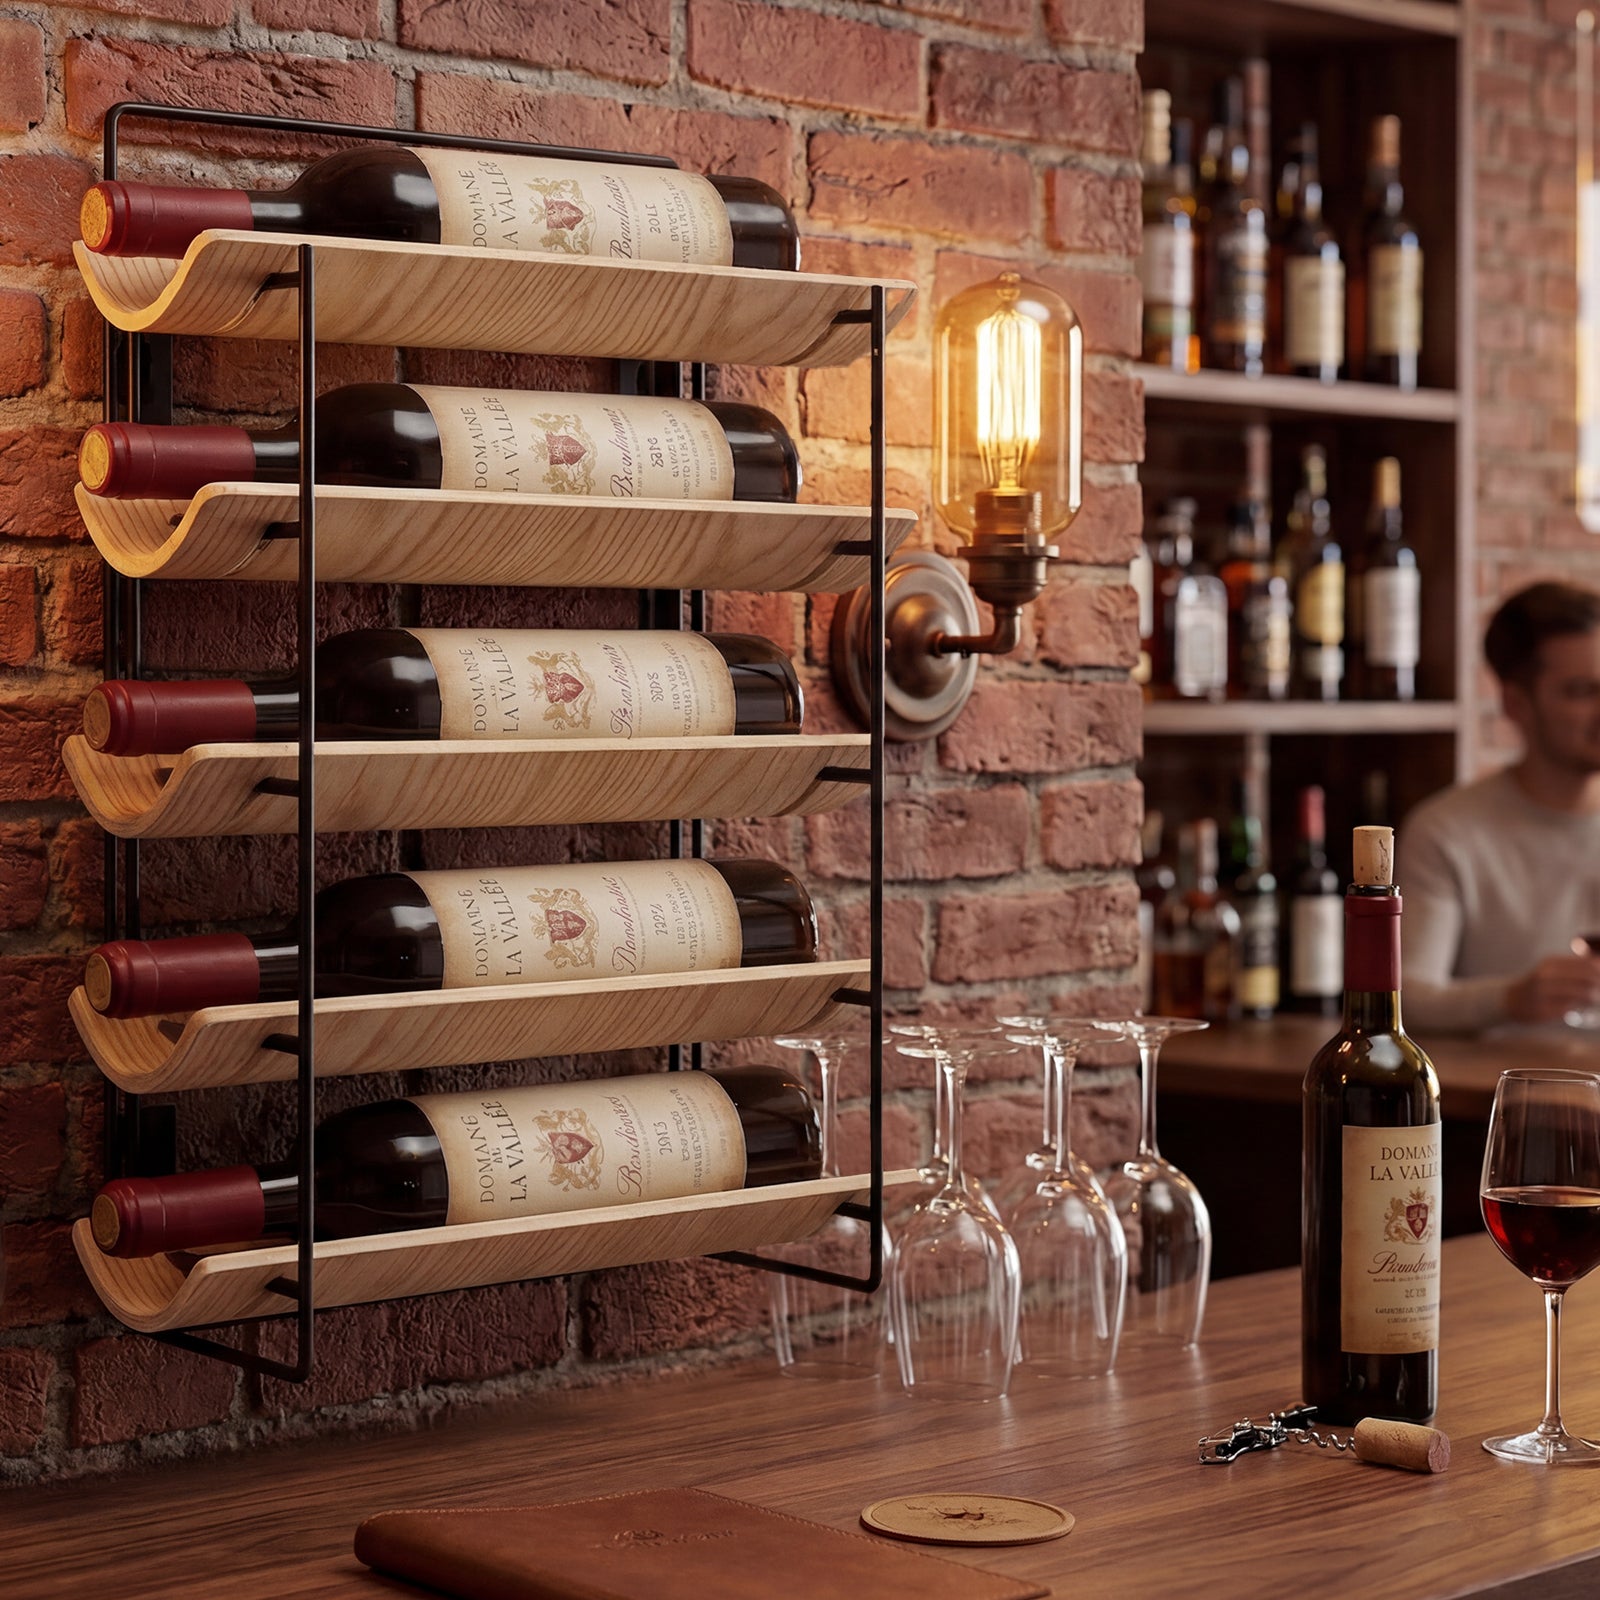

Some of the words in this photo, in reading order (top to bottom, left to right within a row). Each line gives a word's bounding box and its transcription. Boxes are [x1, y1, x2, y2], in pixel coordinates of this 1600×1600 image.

[503, 467, 521, 494] LA
[502, 706, 520, 734] LA
[505, 949, 522, 977] LA
[1370, 1165, 1394, 1181] LA
[510, 1174, 528, 1203] LA
